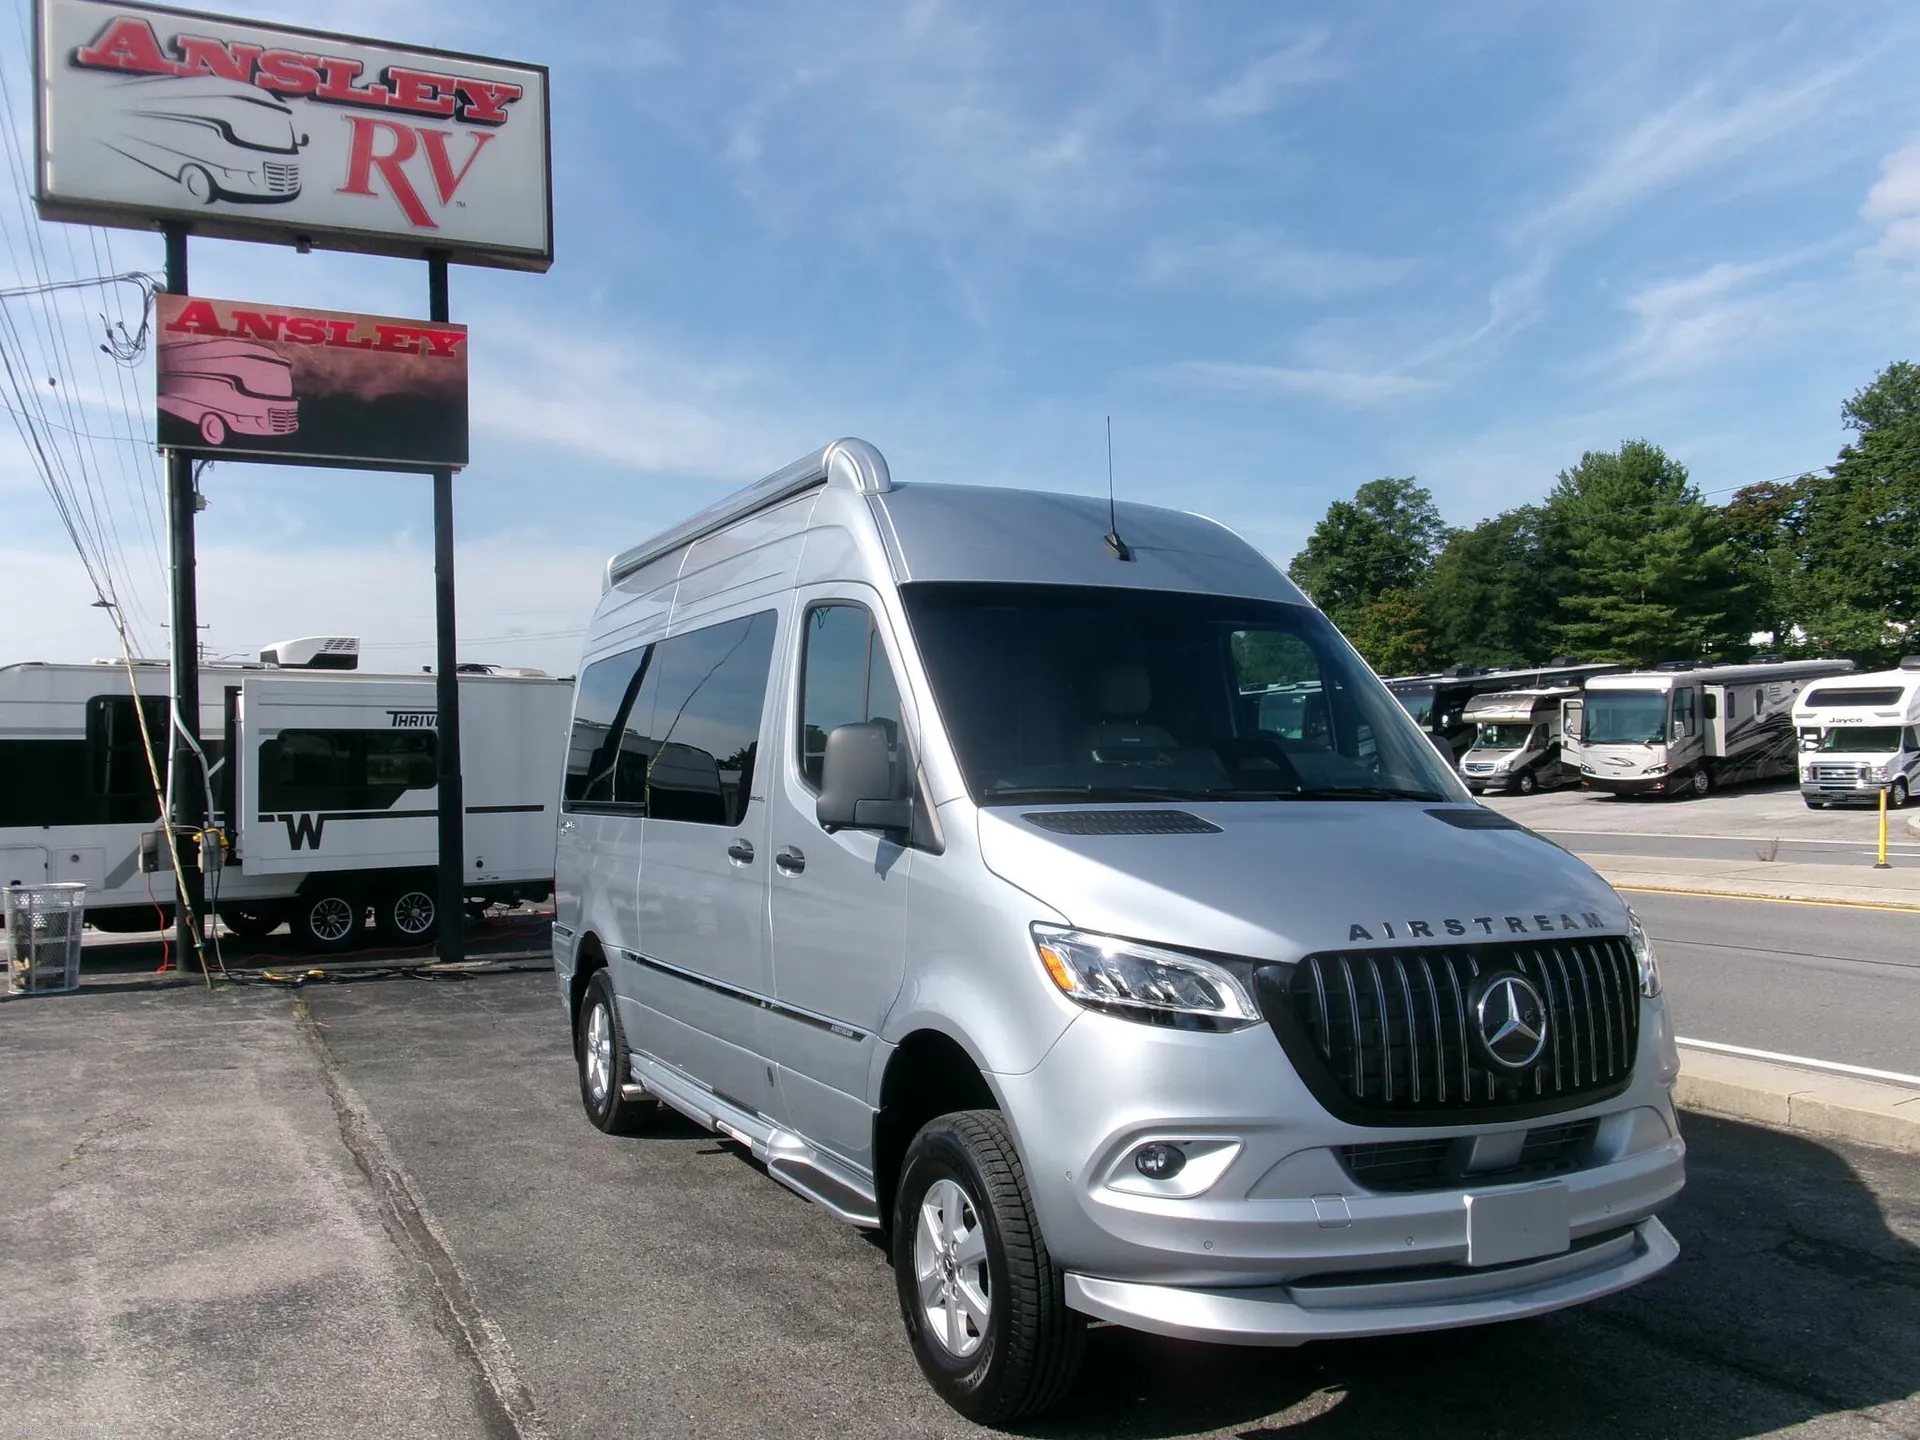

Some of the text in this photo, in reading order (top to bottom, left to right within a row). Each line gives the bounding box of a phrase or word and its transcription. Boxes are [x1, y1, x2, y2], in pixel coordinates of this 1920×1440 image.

[72, 16, 522, 124] ANSLEY
[336, 114, 495, 229] RV
[165, 300, 467, 358] ANSLEY
[386, 711, 439, 727] THRIV
[1828, 716, 1863, 724] Jayco
[1349, 912, 1605, 942] AIRSTREAM
